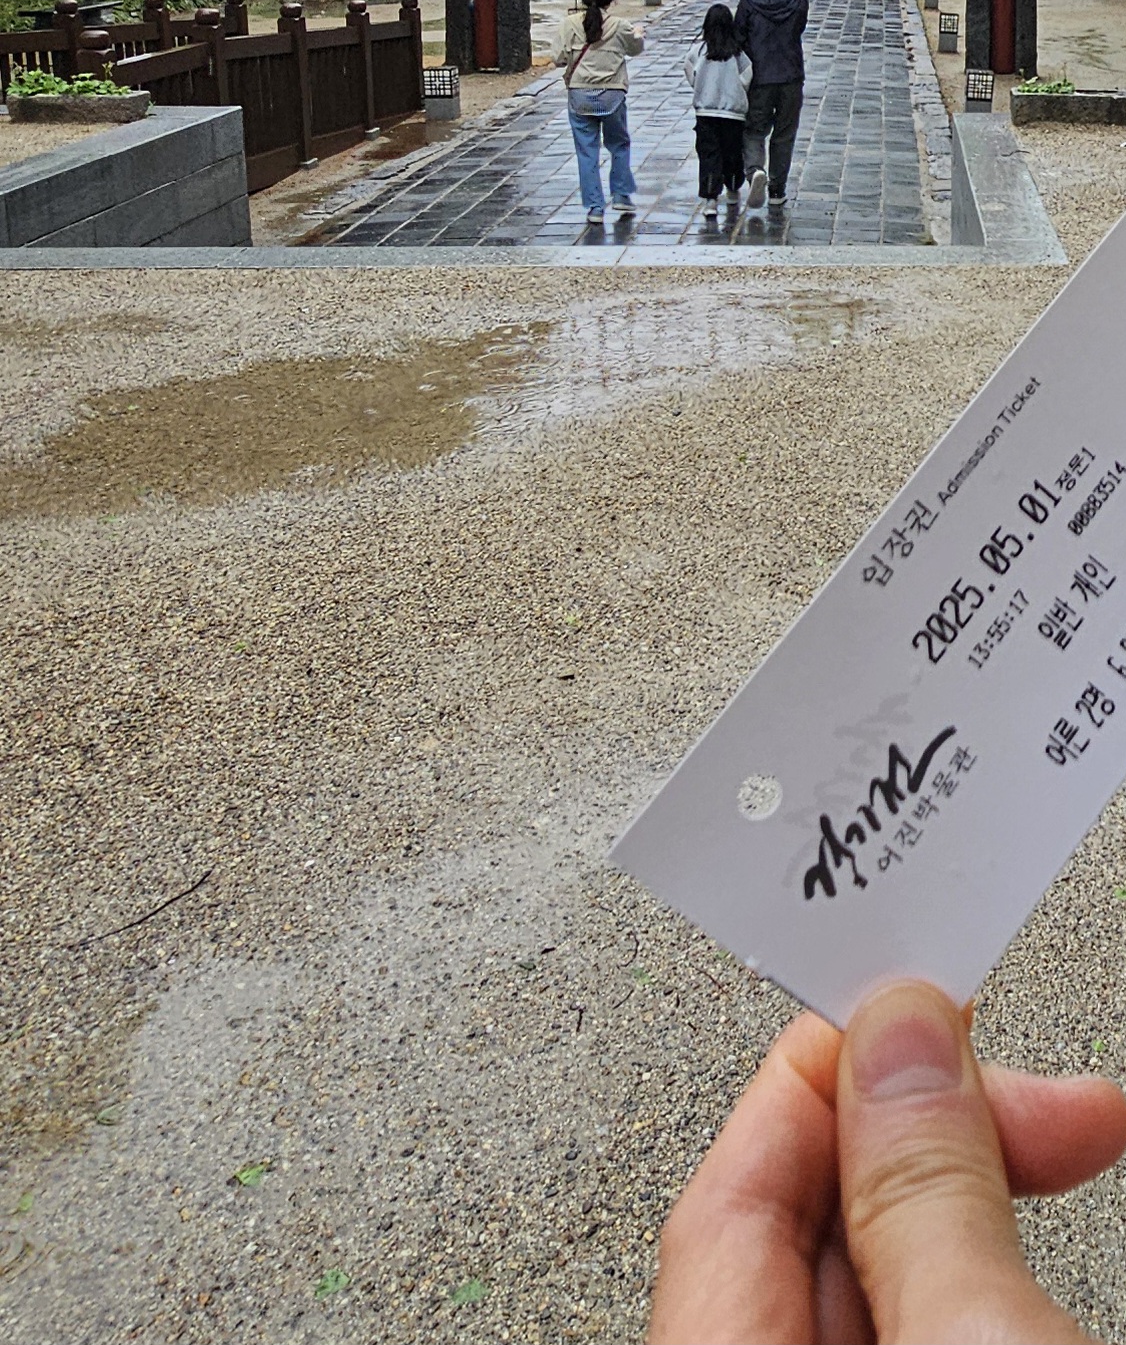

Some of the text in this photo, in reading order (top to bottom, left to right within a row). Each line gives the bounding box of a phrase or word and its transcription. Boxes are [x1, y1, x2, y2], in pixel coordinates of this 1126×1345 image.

[862, 377, 1041, 587] 입장권 Admission Ticket
[968, 588, 1029, 669] 13:55:17
[1038, 554, 1116, 651] 일반 개인
[1045, 717, 1090, 766] 어른
[1075, 681, 1115, 729] 2명
[877, 746, 977, 873] 어진박물관
